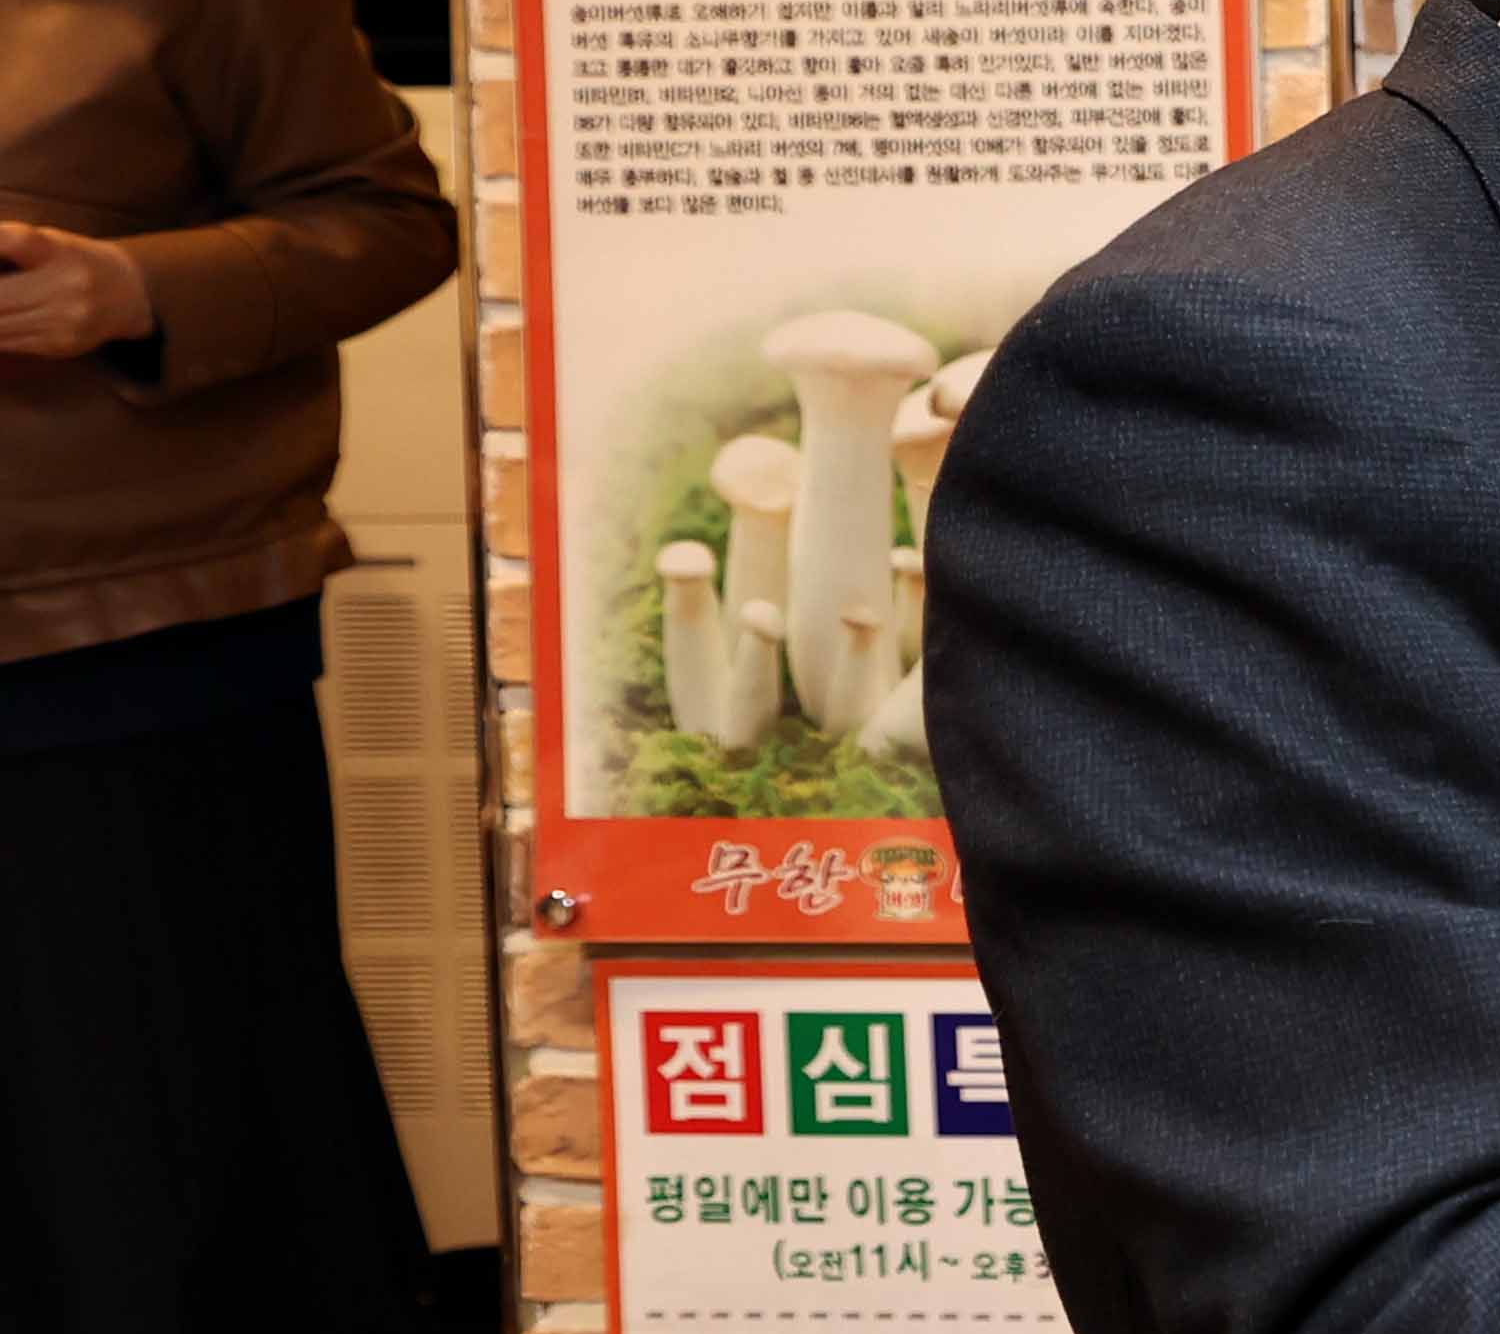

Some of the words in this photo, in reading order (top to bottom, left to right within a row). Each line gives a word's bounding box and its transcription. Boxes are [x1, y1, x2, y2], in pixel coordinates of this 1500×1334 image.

[691, 840, 857, 915] 무한
[645, 1174, 830, 1225] 평일에만
[846, 1175, 935, 1226] 이용
[953, 1176, 1037, 1227] 가능
[772, 1239, 931, 1283] (오전11시
